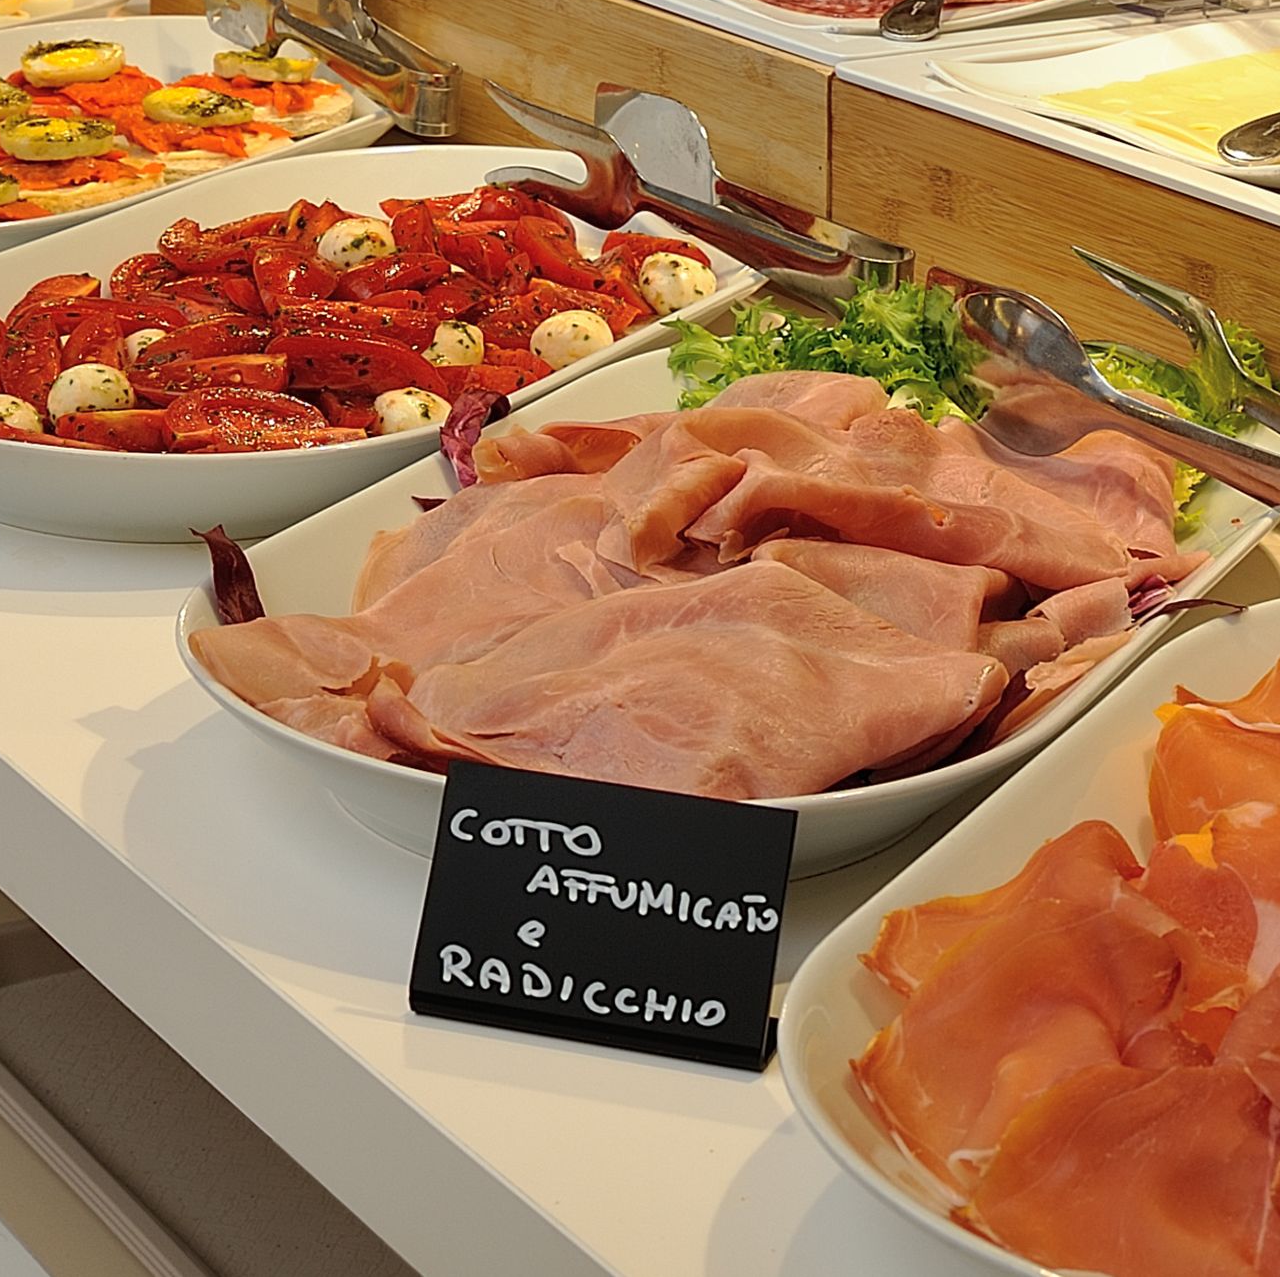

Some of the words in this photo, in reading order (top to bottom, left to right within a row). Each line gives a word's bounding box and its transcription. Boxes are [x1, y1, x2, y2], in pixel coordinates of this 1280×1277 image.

[450, 808, 603, 856] COTTO
[526, 864, 780, 933] AFFUMICATO
[439, 944, 727, 1027] RADICCHIO
